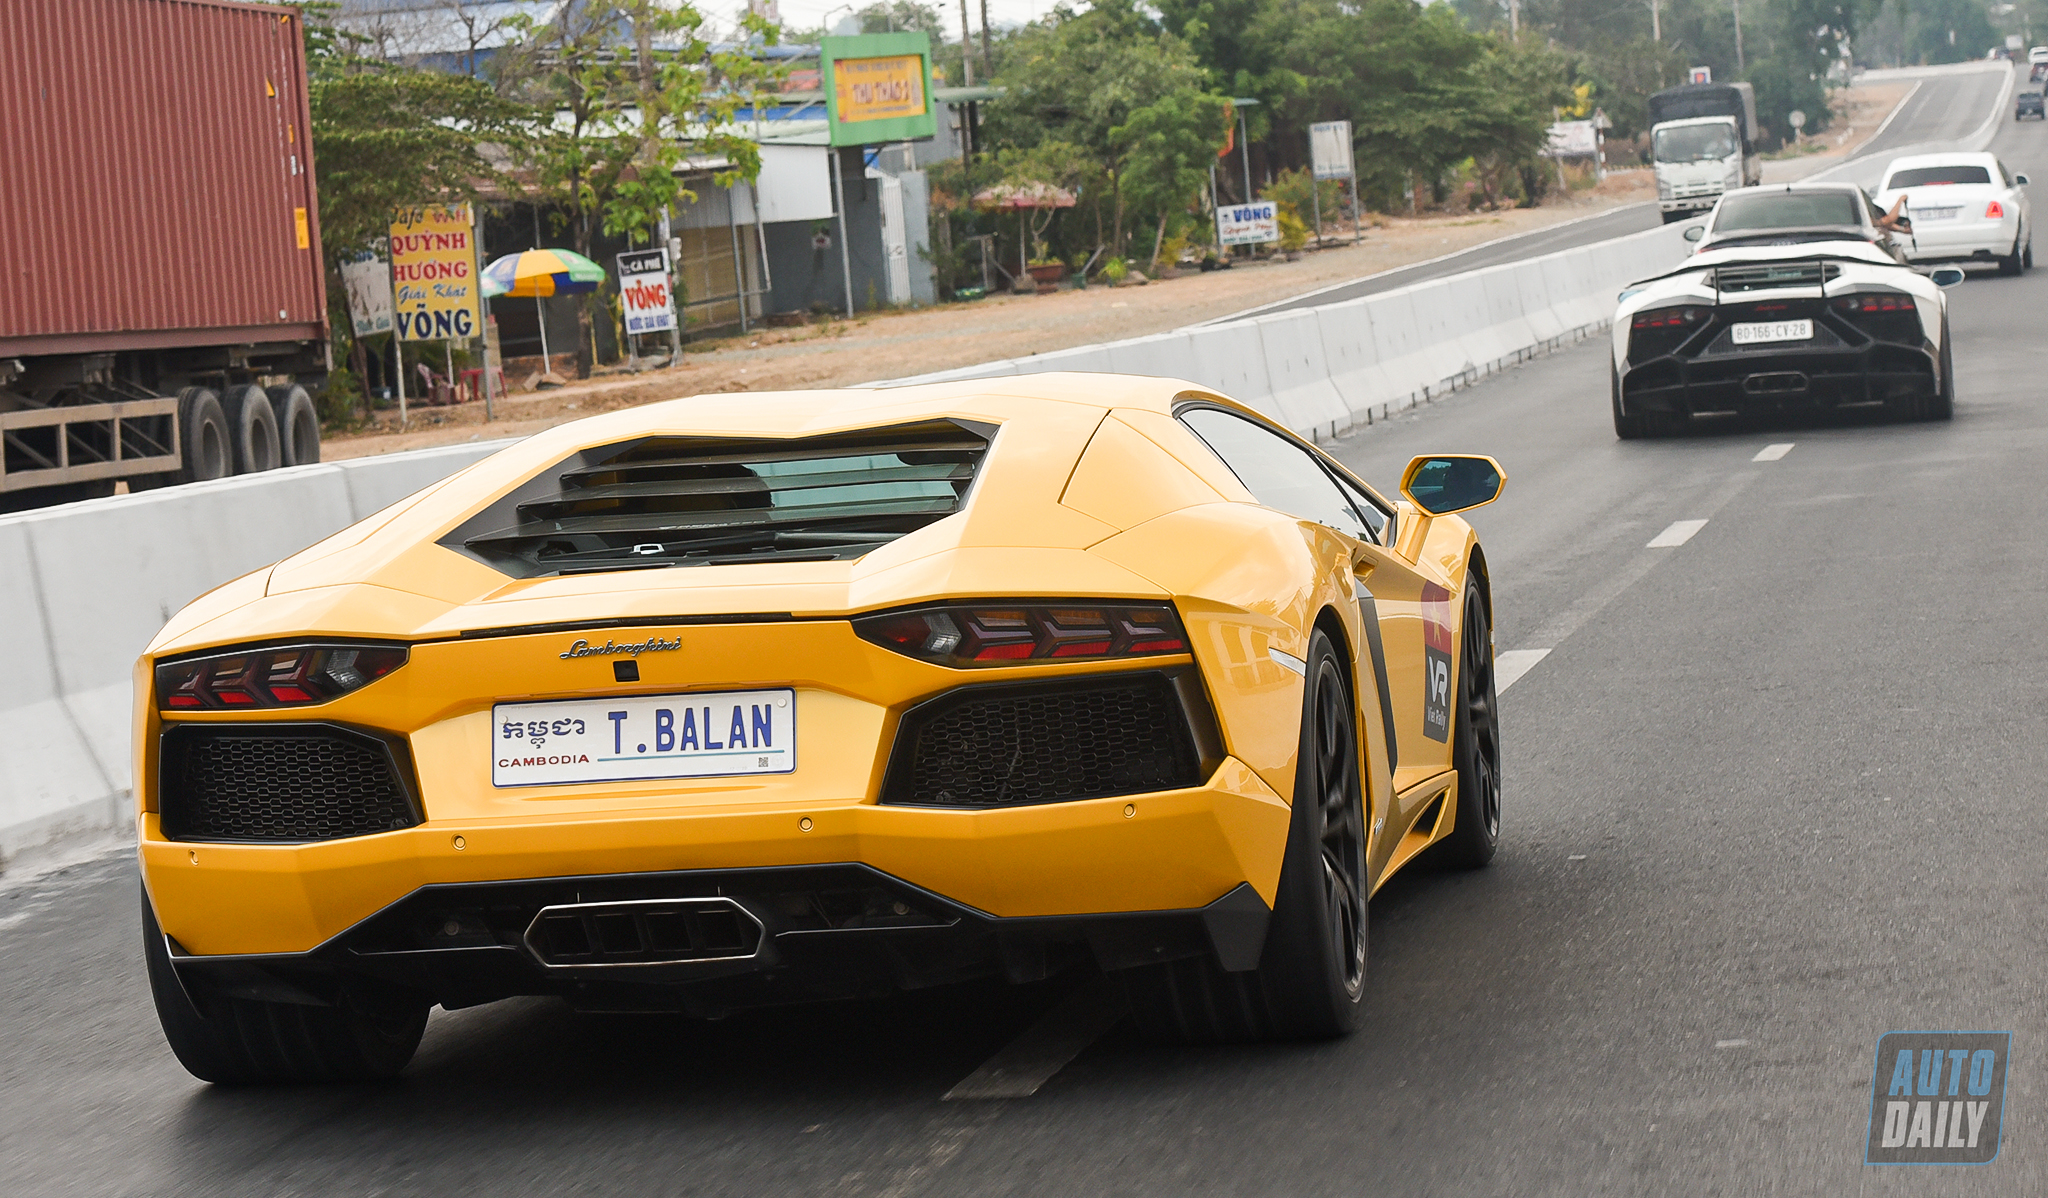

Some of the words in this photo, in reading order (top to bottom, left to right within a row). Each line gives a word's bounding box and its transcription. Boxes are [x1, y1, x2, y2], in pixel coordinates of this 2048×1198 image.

[397, 303, 472, 340] VÕNG
[559, 636, 683, 660] Lamborghini
[1428, 655, 1448, 707] VR
[608, 703, 772, 755] T.BALAN
[498, 754, 590, 769] CAMBODIA
